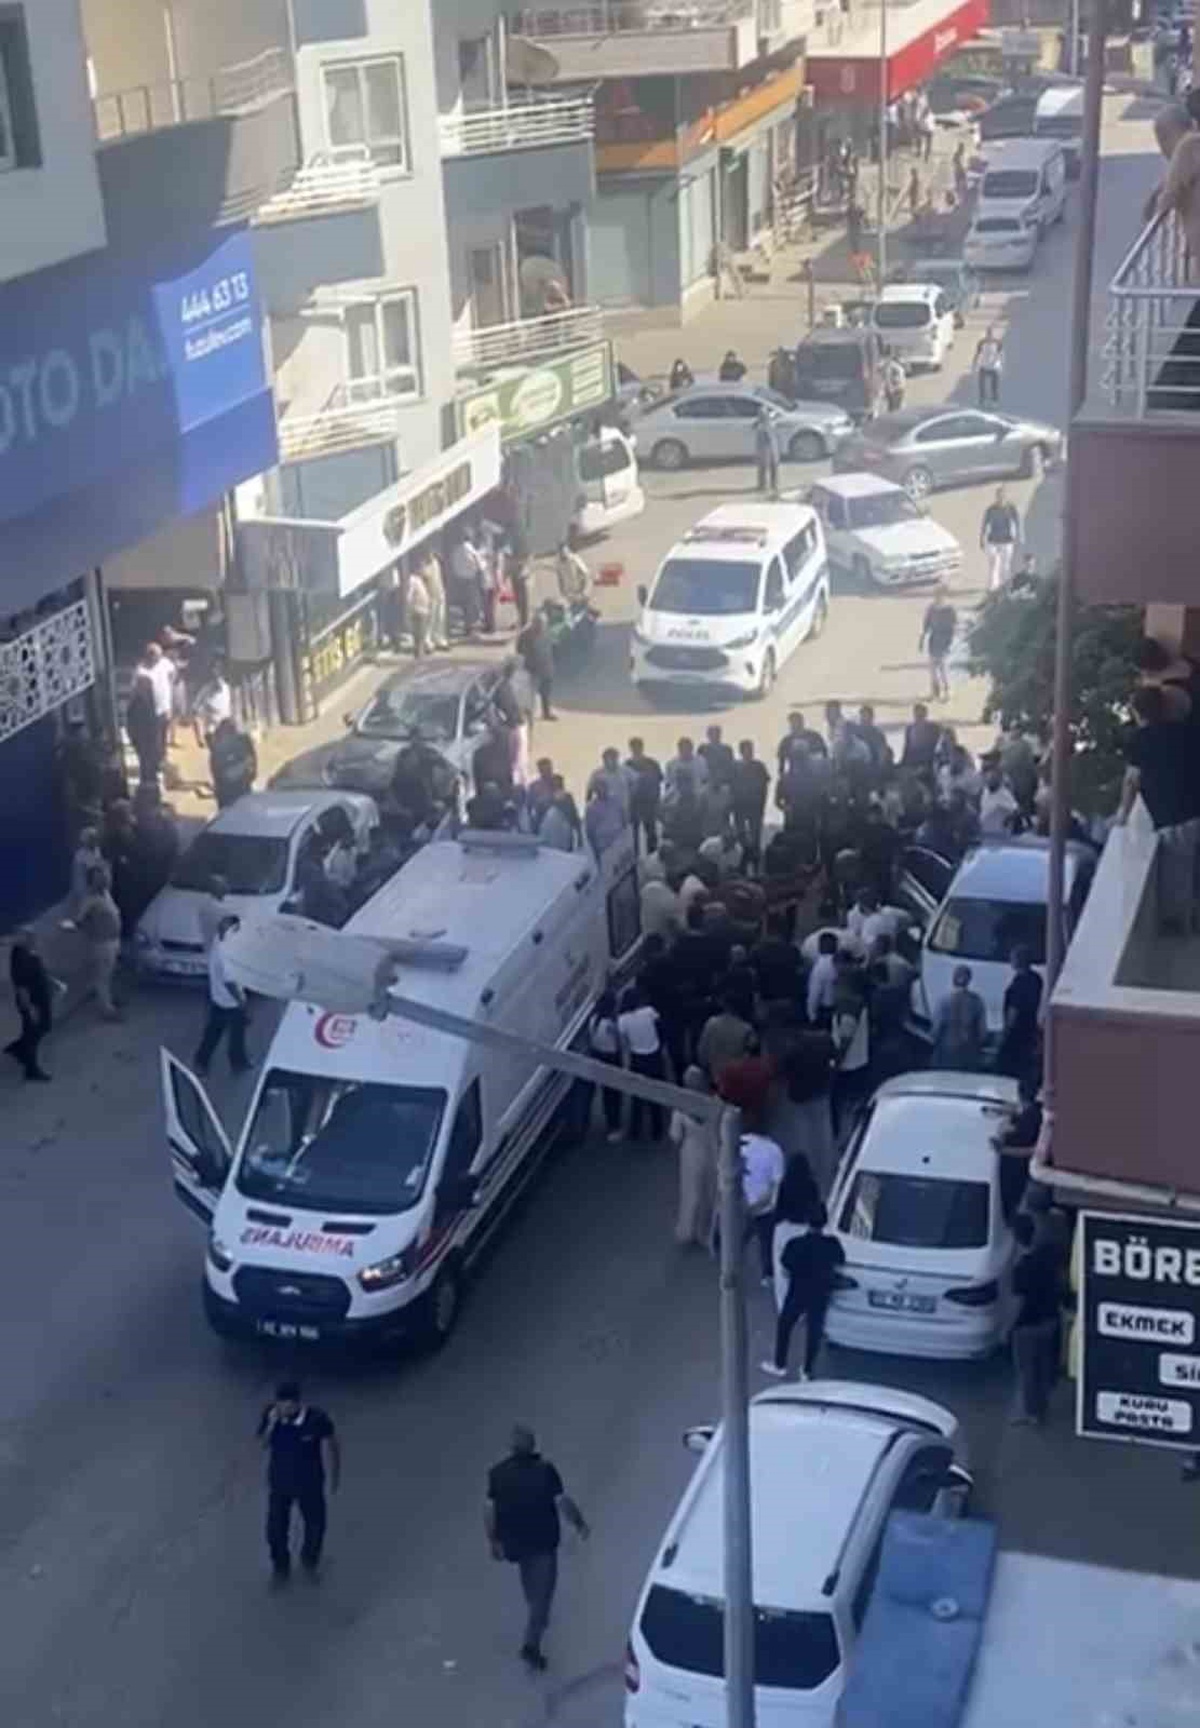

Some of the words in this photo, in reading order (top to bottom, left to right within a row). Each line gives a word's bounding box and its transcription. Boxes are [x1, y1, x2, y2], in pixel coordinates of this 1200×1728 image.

[87, 314, 168, 407] DA
[1094, 1235, 1200, 1286] BÖRE
[1105, 1311, 1186, 1336] EKMEK
[1175, 1362, 1200, 1381] Sİ
